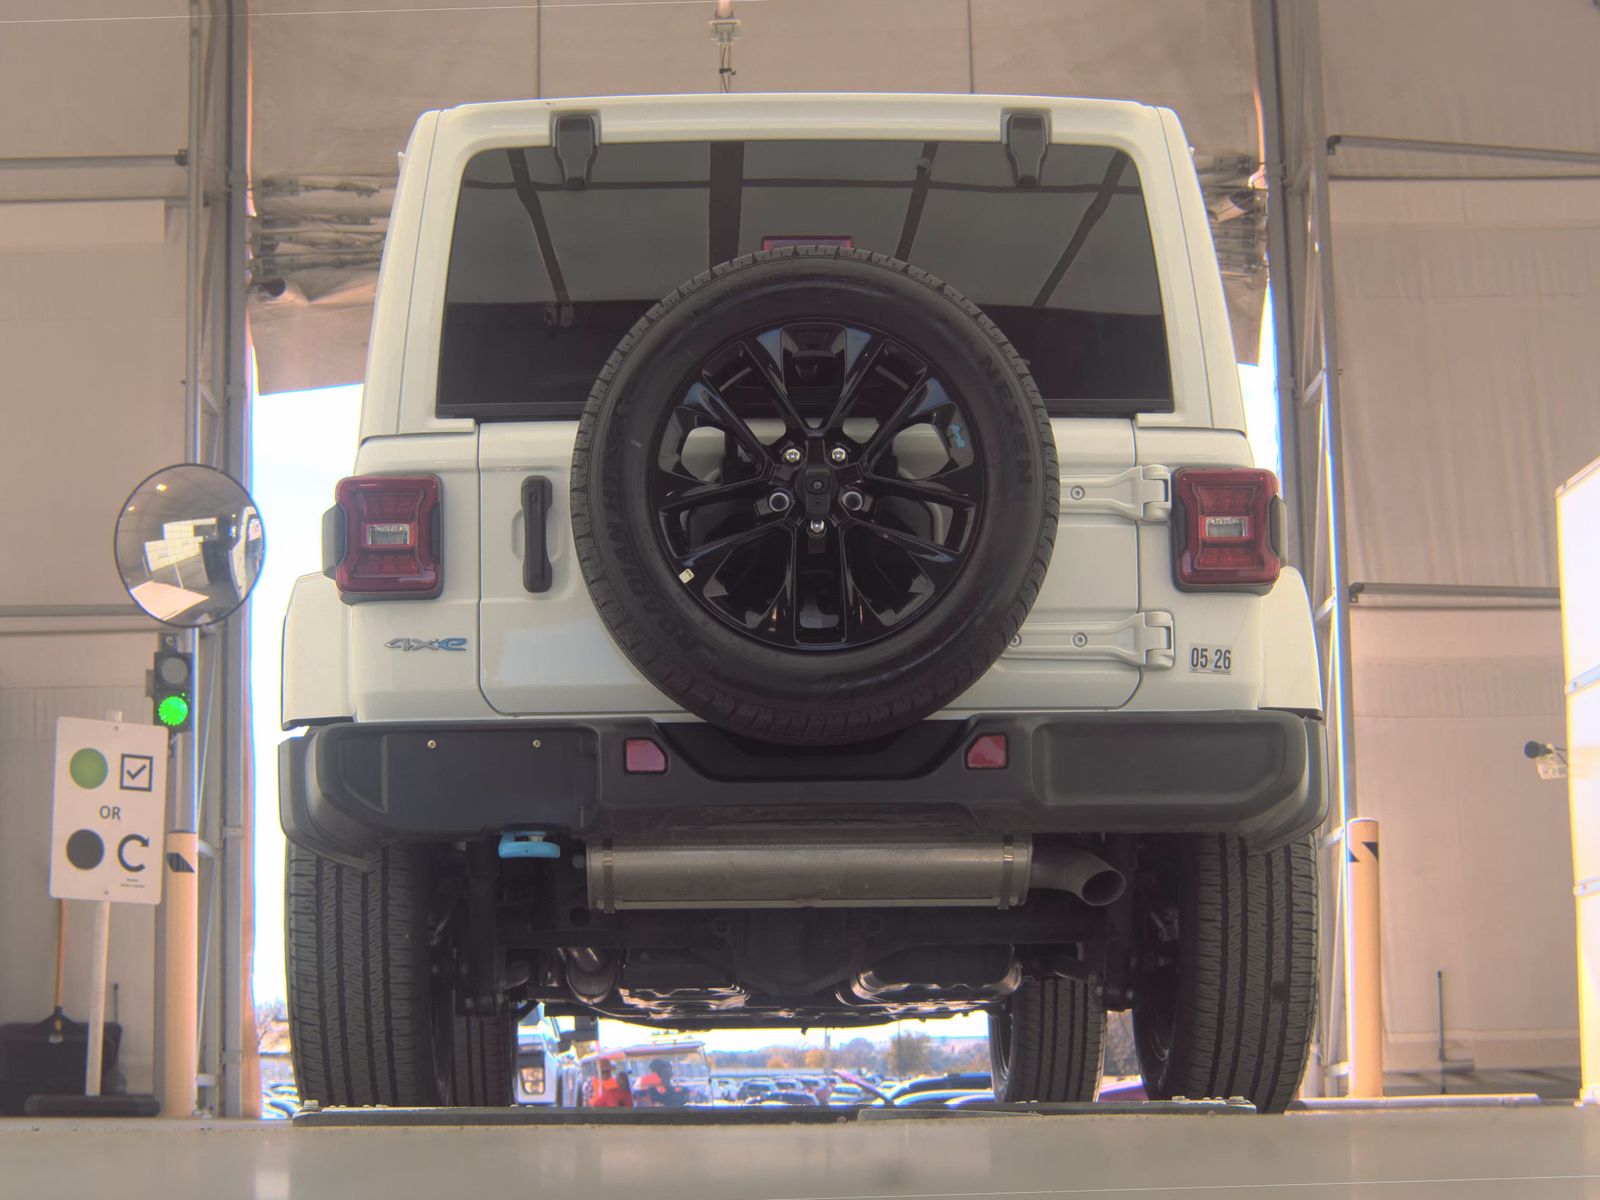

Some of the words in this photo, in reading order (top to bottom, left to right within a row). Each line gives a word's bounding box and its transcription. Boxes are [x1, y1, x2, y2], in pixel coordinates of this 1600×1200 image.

[1191, 647, 1208, 668] 05
[1214, 649, 1231, 669] 26
[99, 805, 121, 821] OR
